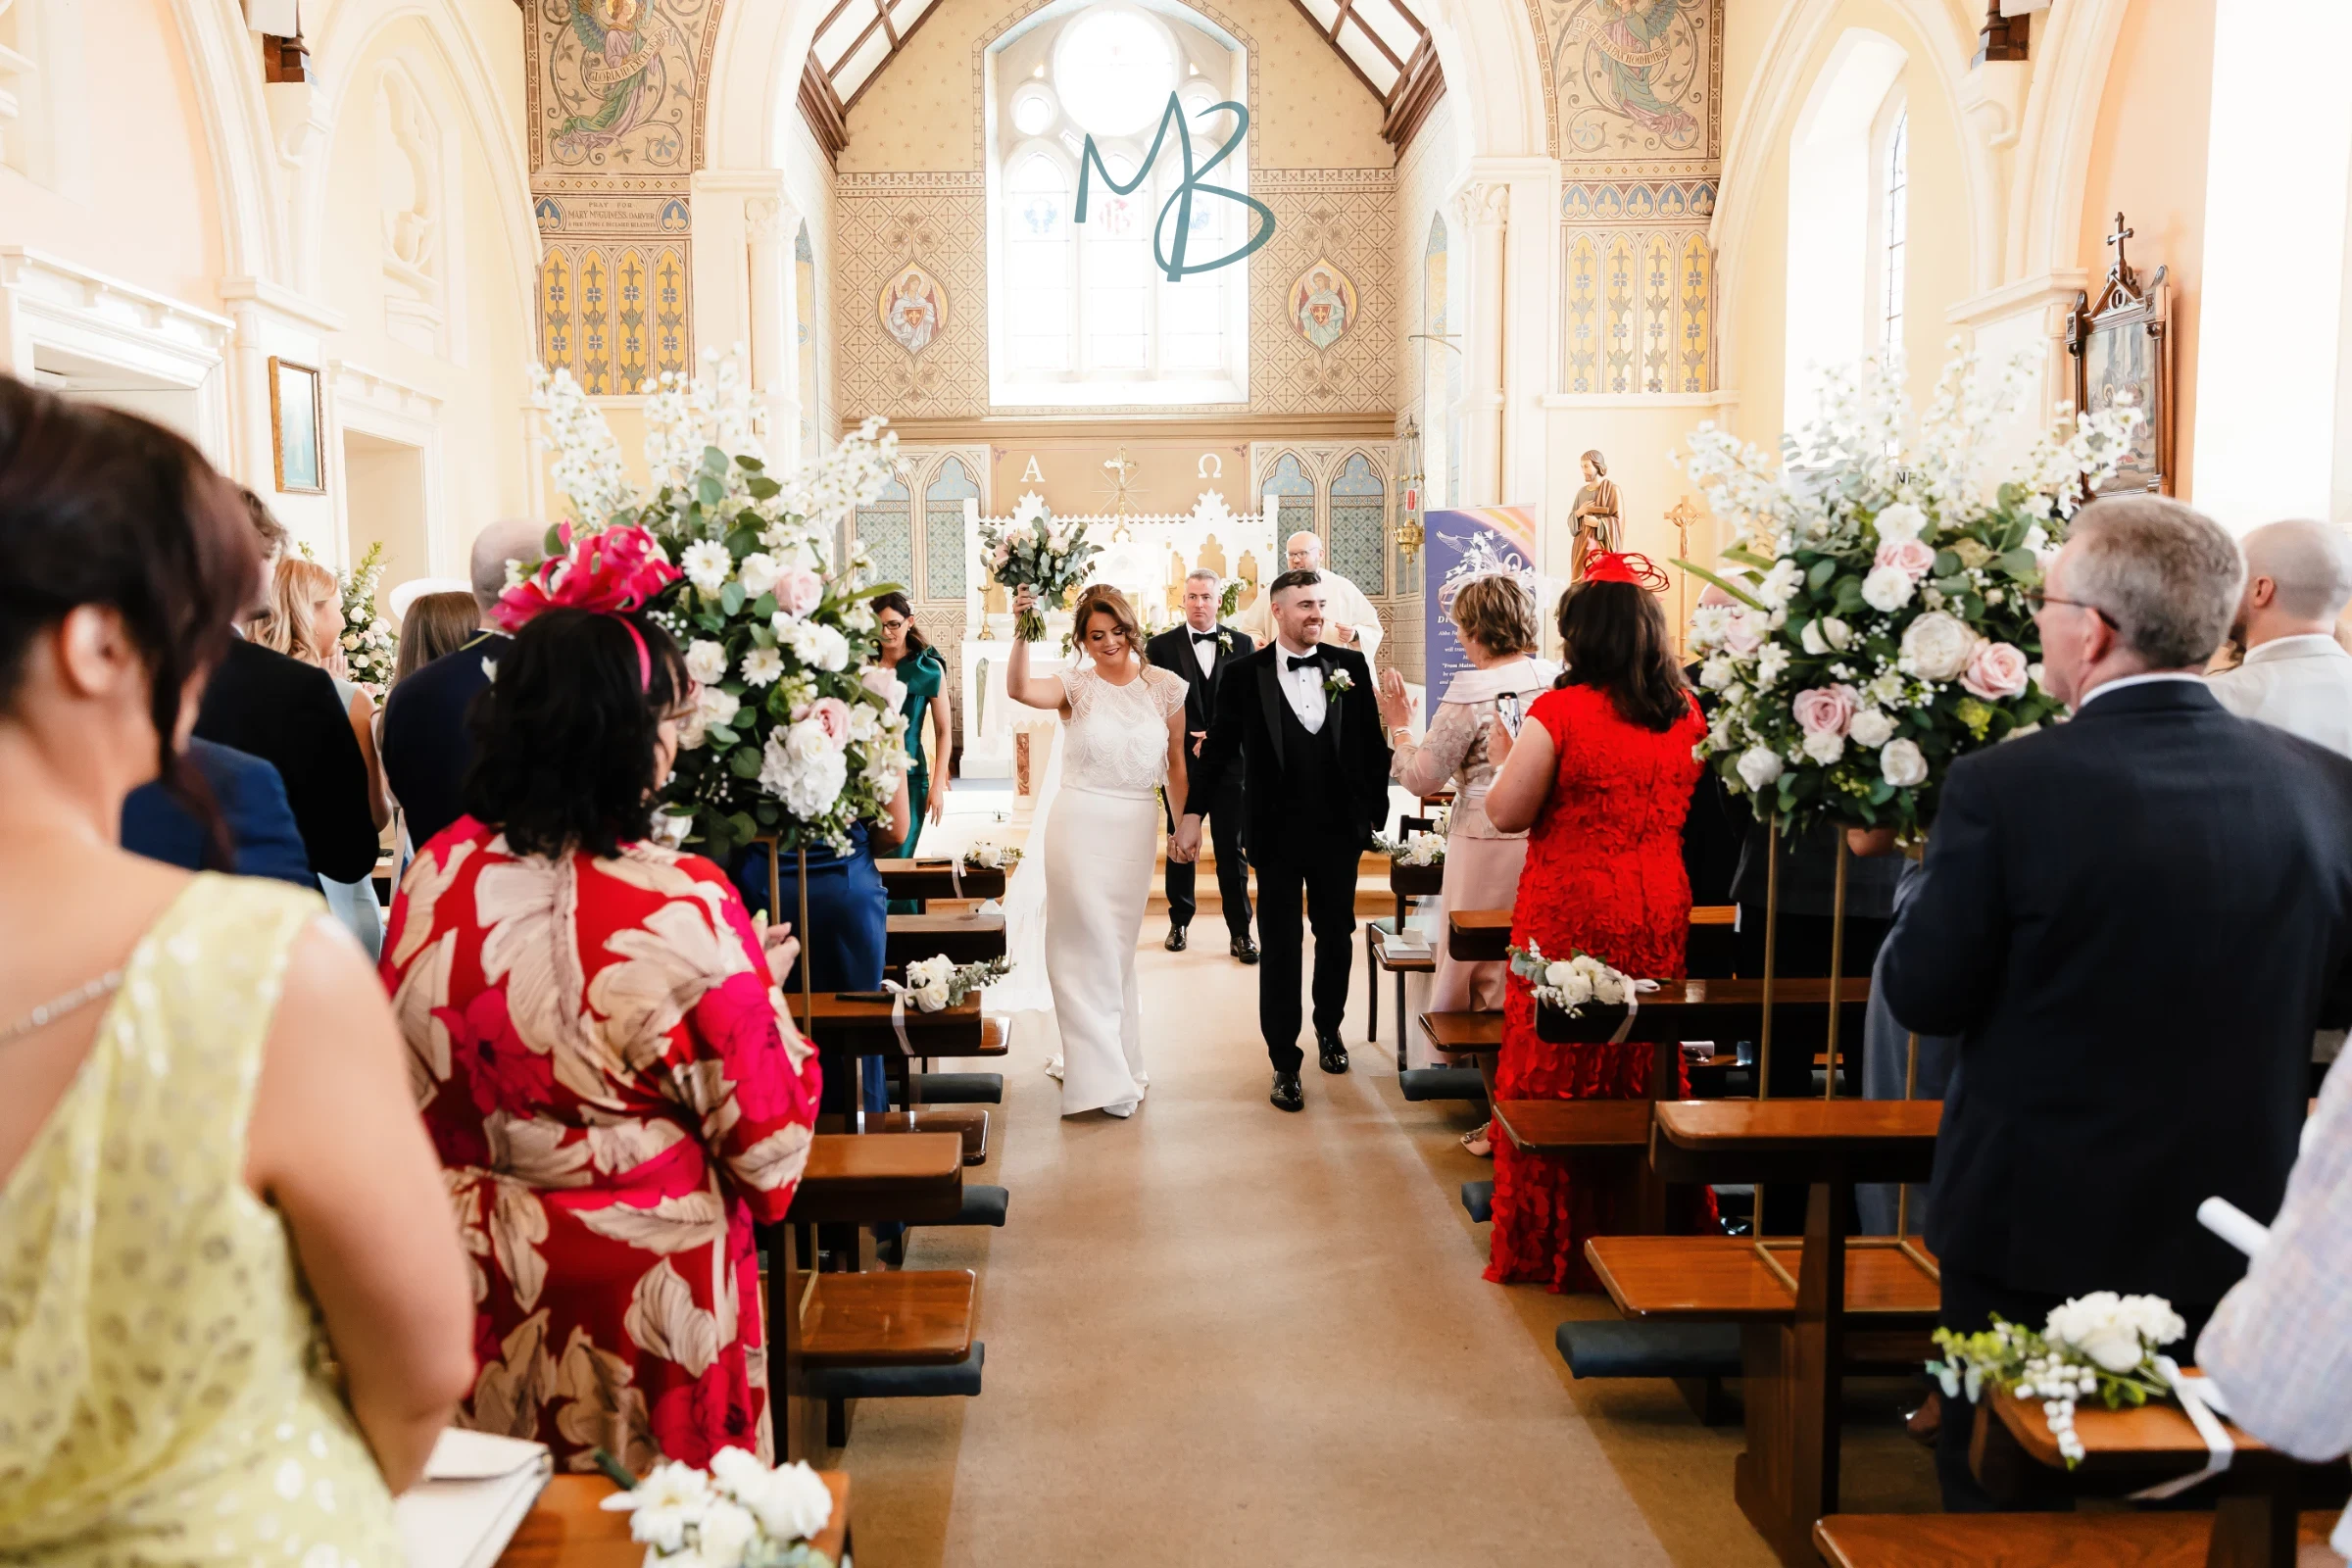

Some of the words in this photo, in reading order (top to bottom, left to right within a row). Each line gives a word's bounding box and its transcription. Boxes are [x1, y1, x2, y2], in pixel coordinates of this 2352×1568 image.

[588, 70, 621, 82] GLORIA
[629, 40, 660, 72] EXCELSIS
[567, 210, 588, 220] MARY
[1198, 453, 1222, 479] Ω
